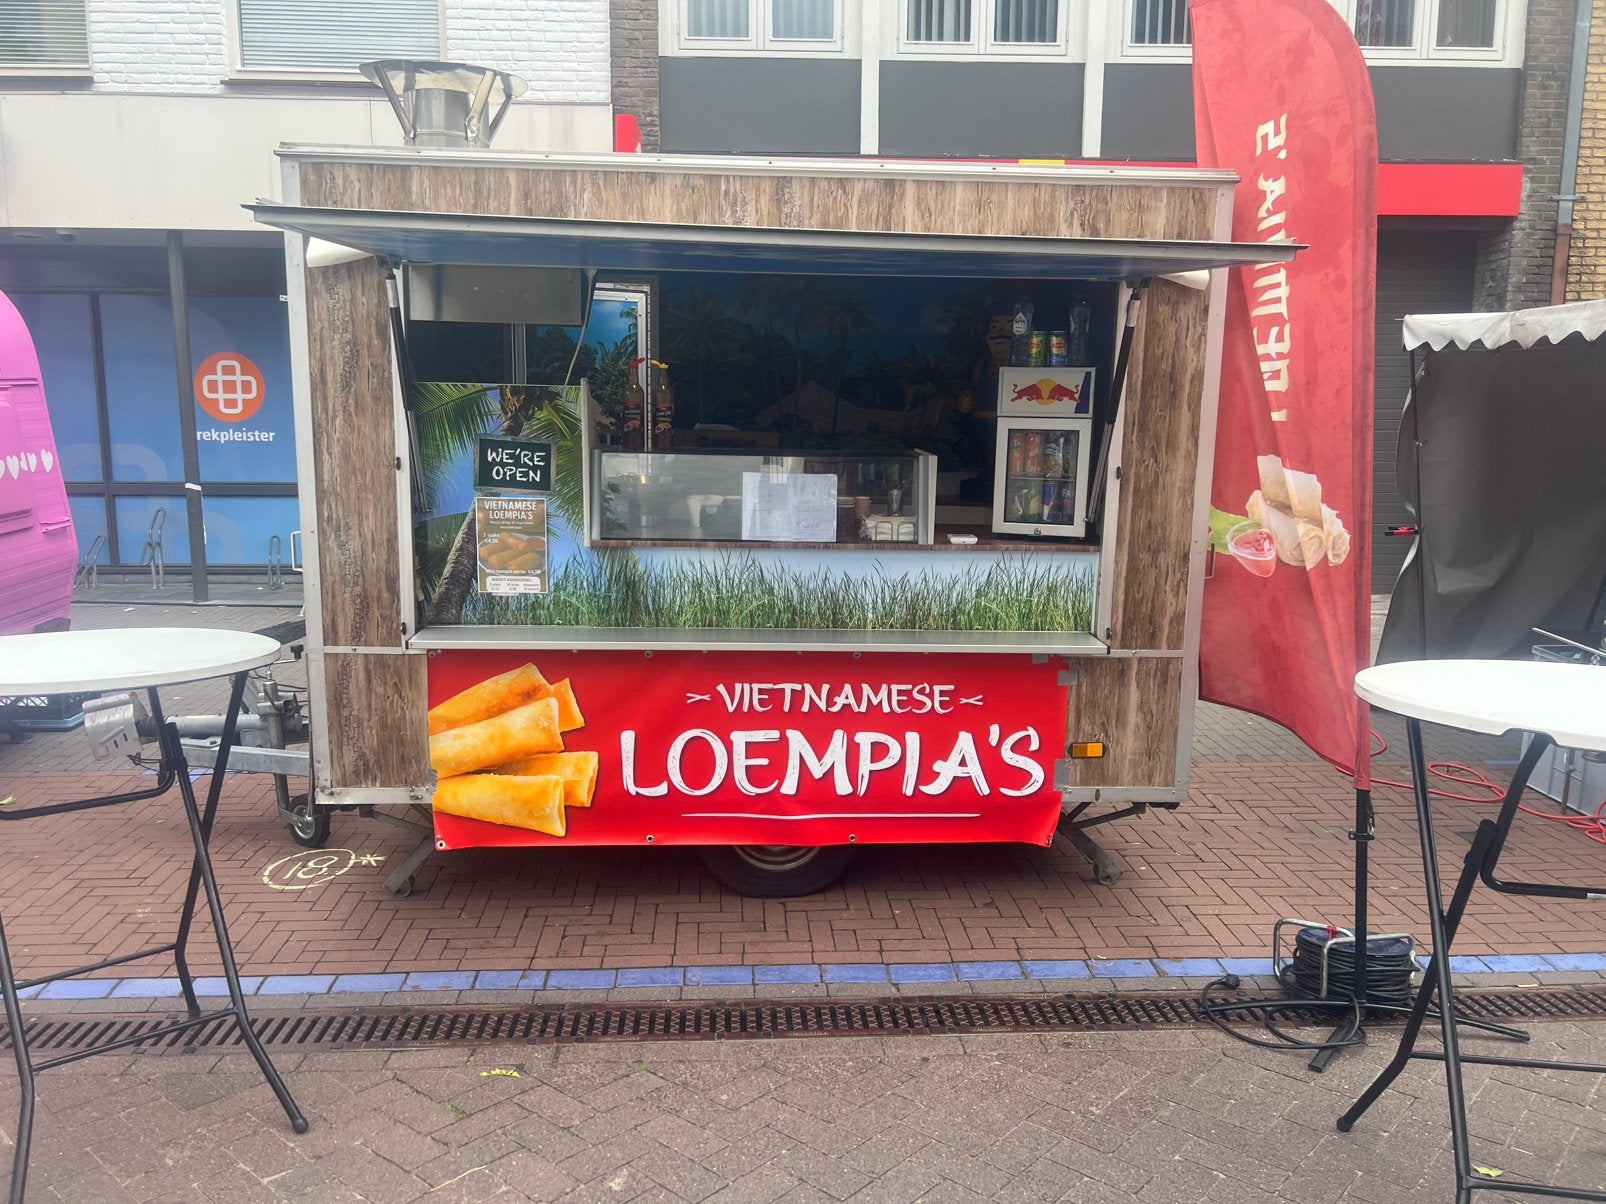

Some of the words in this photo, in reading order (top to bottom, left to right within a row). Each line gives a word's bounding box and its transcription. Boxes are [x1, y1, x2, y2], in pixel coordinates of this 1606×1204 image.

[197, 428, 275, 443] rekpleister
[487, 447, 546, 466] WE'RE
[492, 466, 541, 482] OPEN
[484, 500, 537, 511] VIETNAMESE
[489, 510, 534, 520] LOEMPIA'S
[715, 682, 955, 715] VIETNAMESE
[619, 722, 1045, 798] LOEMPIA'S
[283, 855, 340, 879] 18
